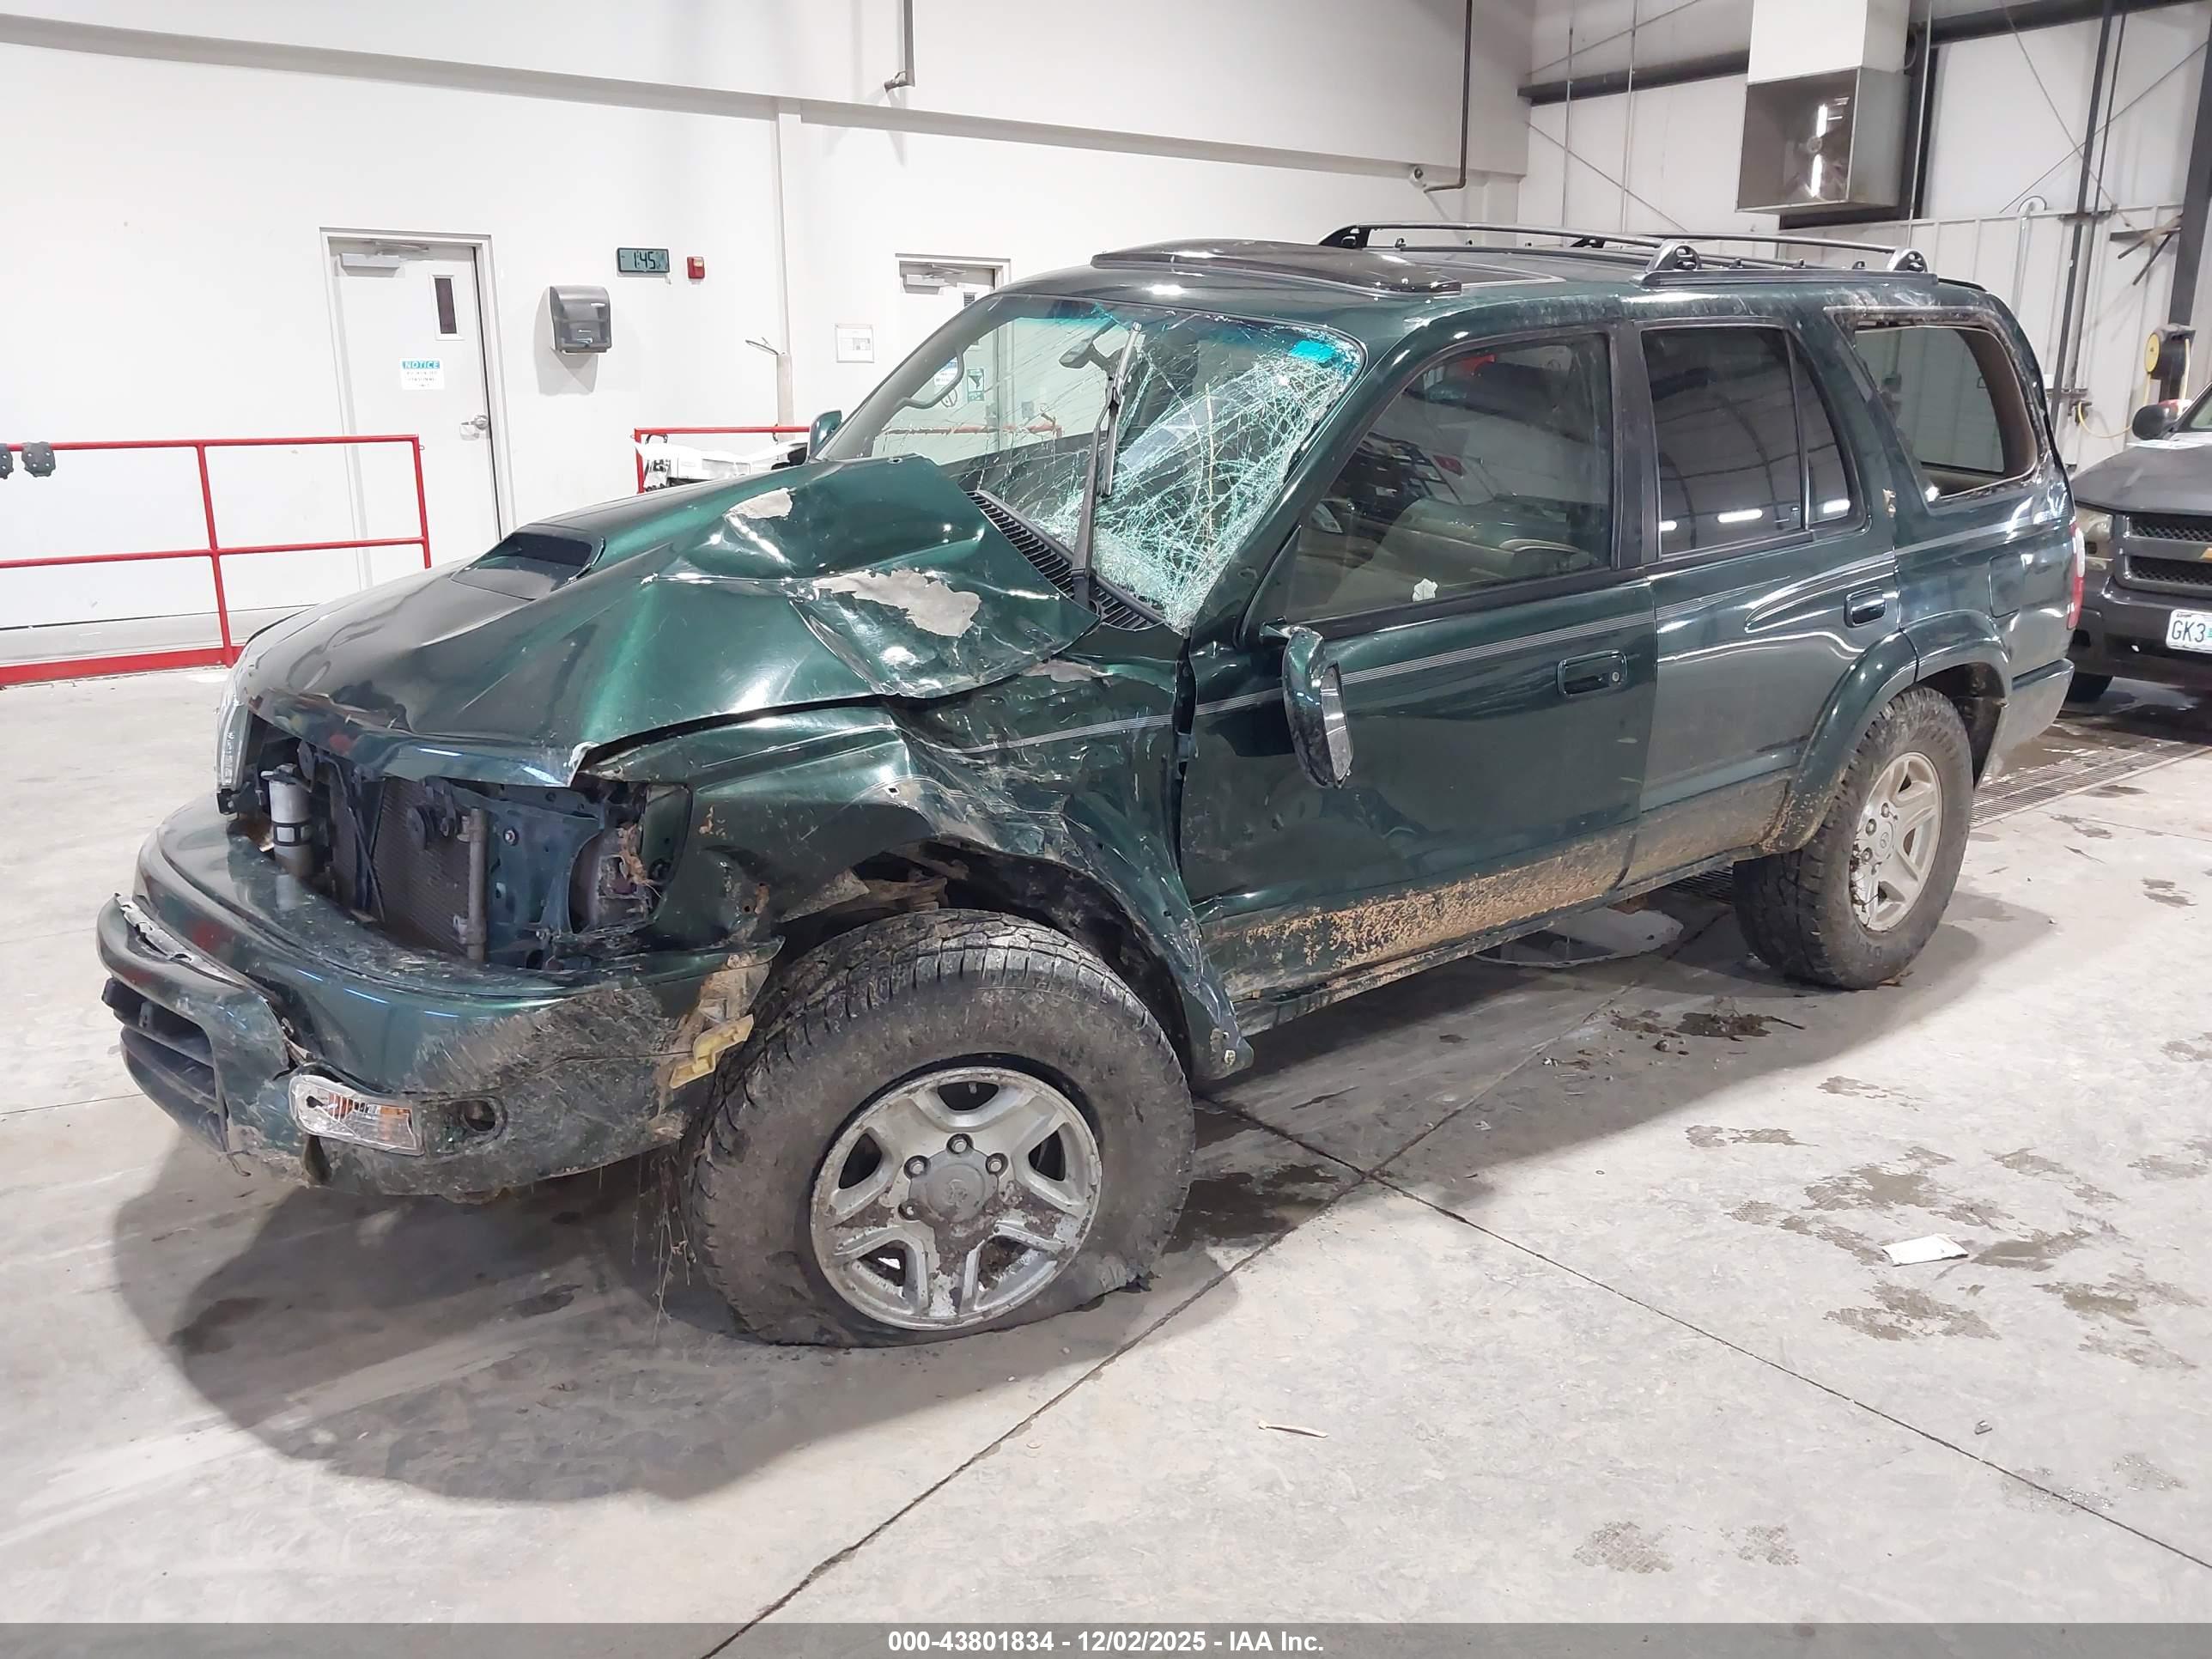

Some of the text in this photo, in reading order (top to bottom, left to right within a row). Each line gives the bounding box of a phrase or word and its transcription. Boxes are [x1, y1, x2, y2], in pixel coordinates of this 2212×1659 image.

[634, 251, 655, 270] 1:45
[404, 361, 440, 369] NOTICE
[2172, 620, 2206, 643] GK3
